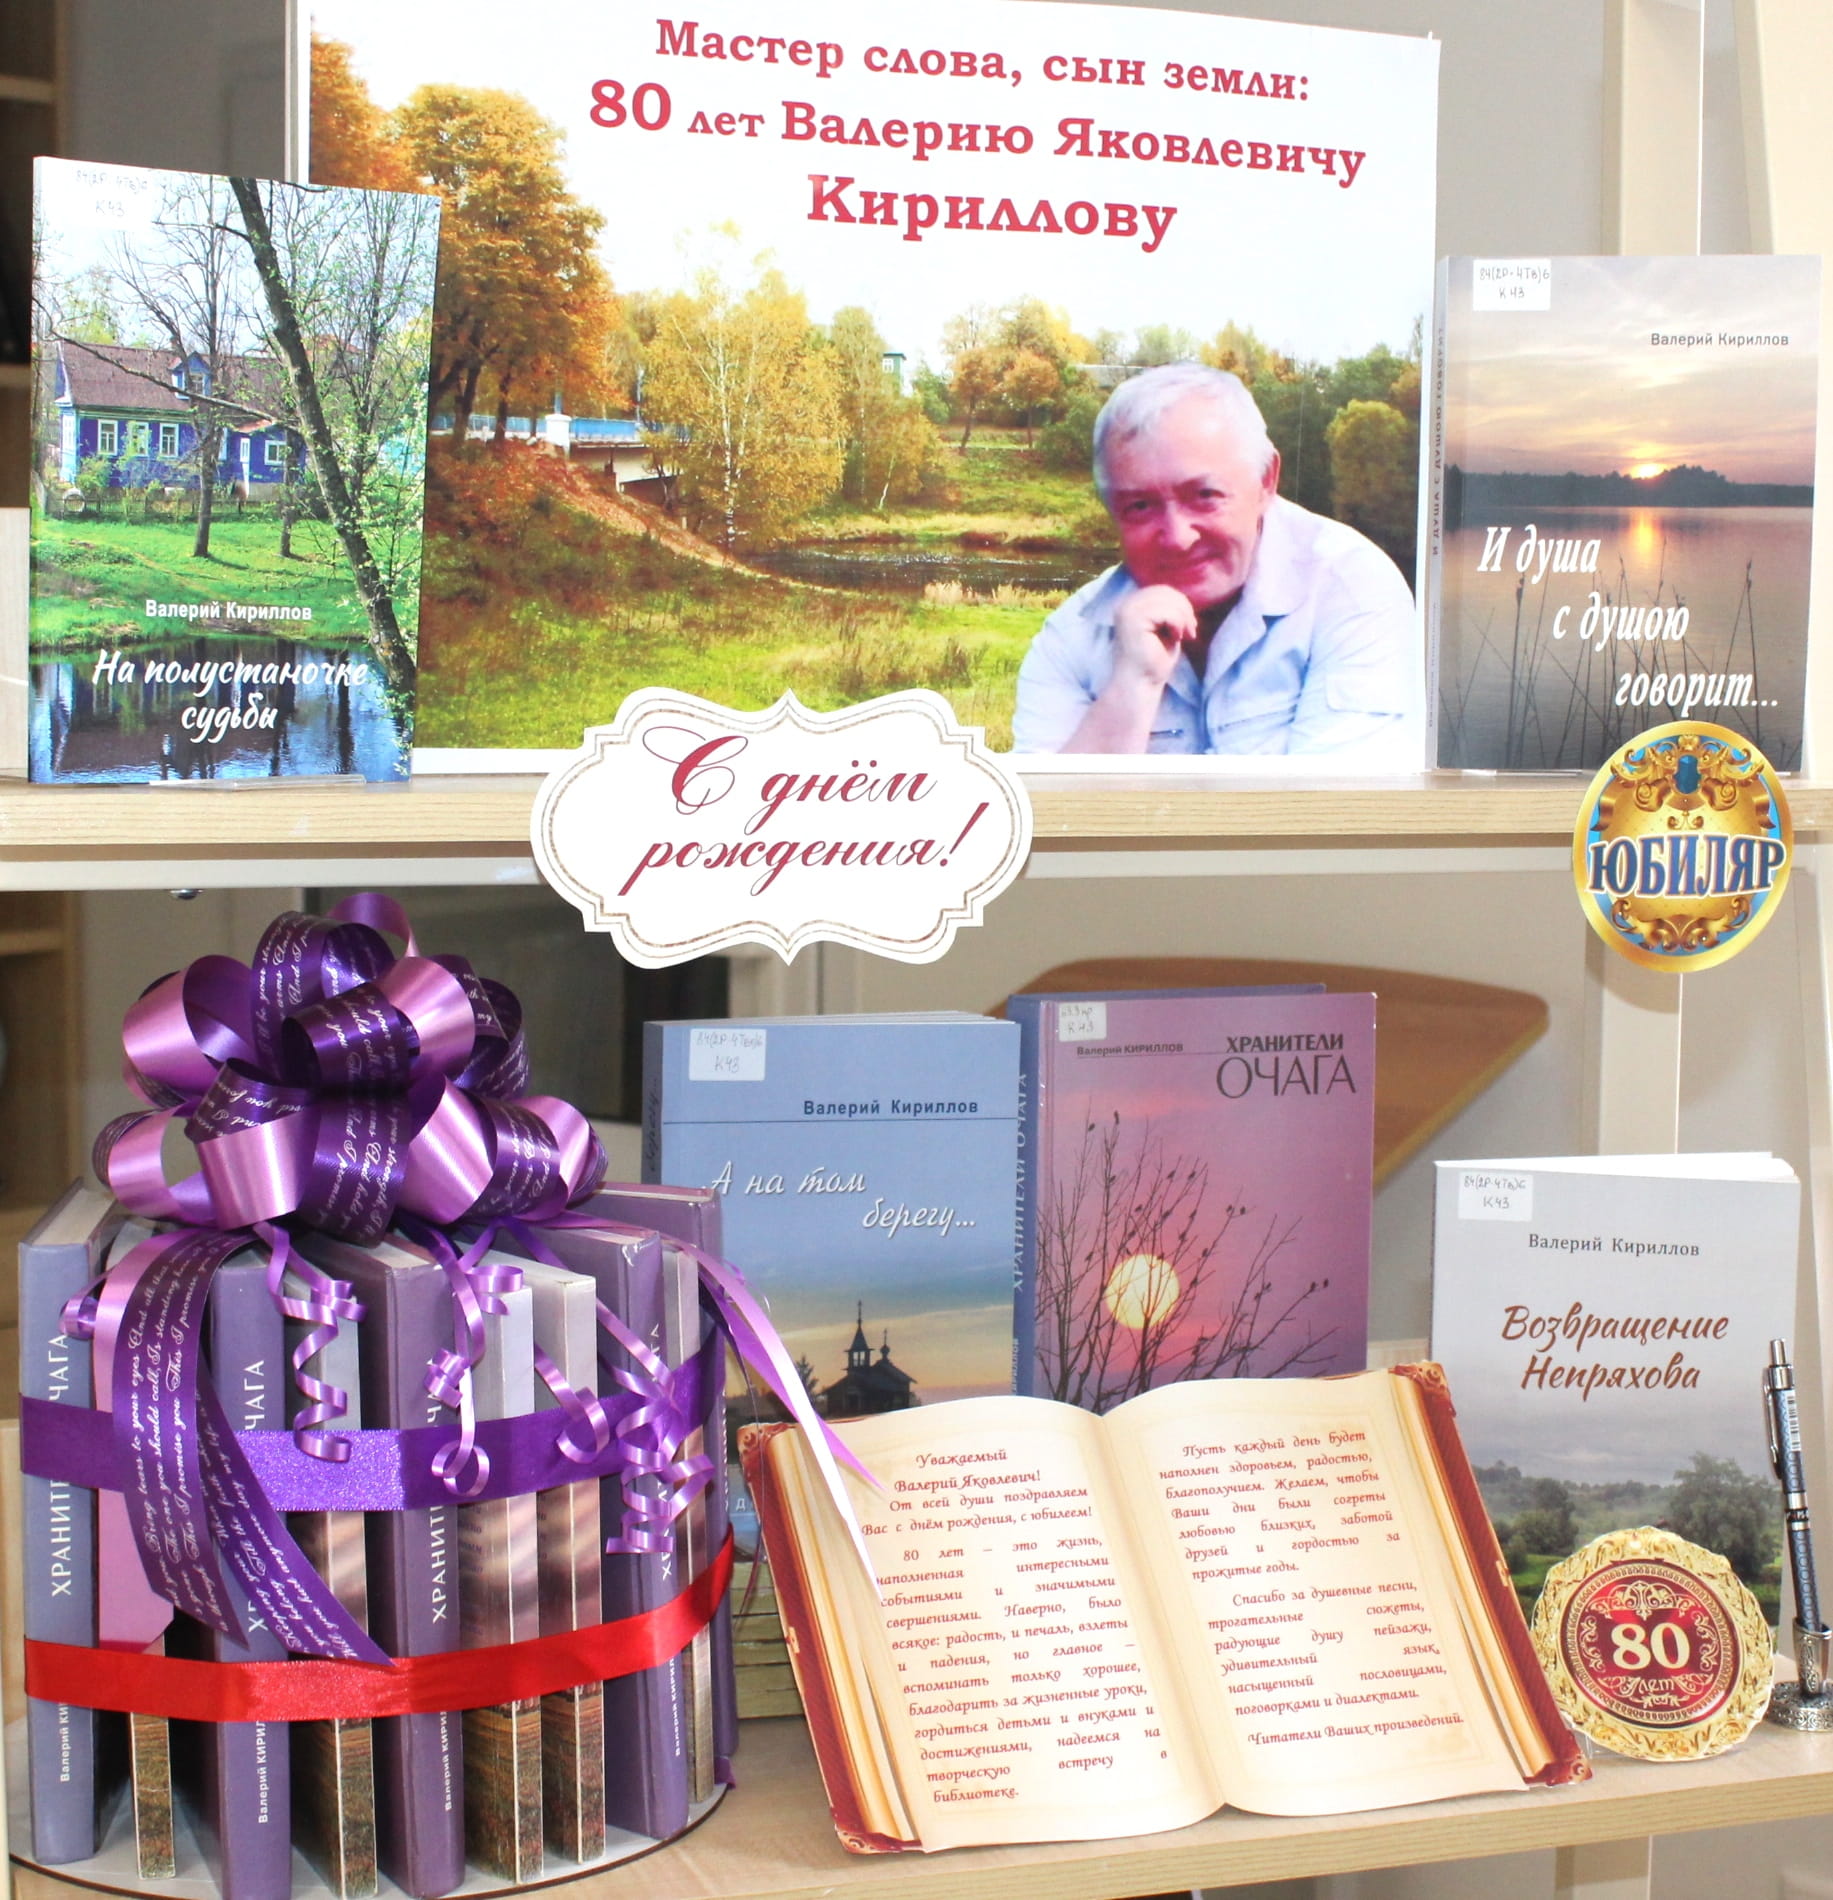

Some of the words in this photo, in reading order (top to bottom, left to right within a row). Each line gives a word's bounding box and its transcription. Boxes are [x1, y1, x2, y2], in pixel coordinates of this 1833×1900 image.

[654, 18, 844, 79] Мастер
[861, 43, 1023, 88] слова,
[1041, 53, 1147, 89] сын
[1163, 60, 1311, 102] земли:
[588, 78, 673, 133] 80
[687, 108, 765, 138] лет
[781, 100, 1034, 160] Валерию
[1053, 118, 1368, 188] Яковлевичу
[806, 173, 1178, 254] Кириллову
[1650, 332, 1713, 349] Валерий
[1718, 333, 1789, 349] Кириллов
[1477, 526, 1512, 573] И
[1515, 523, 1602, 585] душа
[145, 599, 221, 622] Валерий
[225, 601, 313, 623] Кириллов
[1552, 607, 1571, 640] с
[1579, 591, 1690, 652] душою
[92, 648, 135, 686] На
[143, 658, 368, 698] полустаночке
[1615, 671, 1779, 718] говорит...
[181, 691, 278, 744] судьбы
[642, 725, 749, 815] С
[743, 758, 938, 836] днём
[617, 801, 990, 897] рождения!
[1586, 832, 1787, 899] ЮБИЛЯР
[1076, 1046, 1122, 1057] Валерий
[1124, 1043, 1184, 1054] КИРИЛЛОВ
[1226, 1033, 1344, 1054] ХРАНИТЕЛИ
[1216, 1054, 1357, 1099] ОЧАГА
[803, 1099, 880, 1119] Валерий
[891, 1099, 979, 1118] Кириллов
[701, 1160, 734, 1195] А
[745, 1169, 785, 1195] на
[797, 1166, 866, 1195] том
[862, 1197, 977, 1239] берегу...
[1528, 1233, 1602, 1253] Валерий
[1611, 1238, 1701, 1257] Кириллов
[1500, 1301, 1730, 1353] Возвращение
[132, 1354, 144, 1387] eyes
[165, 1349, 182, 1392] This
[1520, 1351, 1701, 1402] Непряхова
[131, 1392, 144, 1432] your
[174, 1397, 186, 1429] you
[146, 1405, 162, 1458] should
[1183, 1445, 1226, 1459] Пусть
[1234, 1438, 1285, 1454] каждый
[1293, 1436, 1320, 1447] день
[1329, 1430, 1365, 1447] будет
[173, 1432, 192, 1498] promise
[916, 1449, 1007, 1468] Уважаемый
[1160, 1467, 1219, 1479] наполнен
[1230, 1461, 1296, 1475] здоровьем,
[1306, 1453, 1372, 1470] радостью,
[157, 1461, 171, 1493] you
[894, 1477, 958, 1494] Валерий
[957, 1470, 1040, 1488] Яковлевич!
[1166, 1483, 1264, 1499] благополучием.
[1275, 1478, 1328, 1491] Желаем,
[1336, 1469, 1379, 1484] чтобы
[890, 1501, 912, 1511] От
[923, 1497, 950, 1508] всей
[960, 1495, 994, 1509] души
[1004, 1489, 1088, 1503] поздравляем
[1171, 1508, 1210, 1519] Ваши
[1233, 1502, 1256, 1513] дни
[1278, 1497, 1311, 1509] были
[1334, 1493, 1386, 1507] согреты
[861, 1524, 887, 1536] Вас
[910, 1519, 944, 1531] днём
[947, 1514, 1016, 1532] рождения,
[1031, 1506, 1091, 1521] юбилеем!
[1179, 1525, 1235, 1539] любовью
[1261, 1520, 1315, 1531] близких,
[1341, 1511, 1393, 1524] заботой
[904, 1550, 919, 1561] 80
[939, 1549, 964, 1558] лет
[1013, 1542, 1037, 1551] это
[1057, 1537, 1102, 1549] жизнь,
[1186, 1546, 1228, 1562] друзей
[1292, 1537, 1359, 1552] гордостью
[1387, 1533, 1400, 1541] за
[1016, 1558, 1109, 1573] интересными
[1192, 1565, 1261, 1583] прожитые
[1266, 1560, 1299, 1572] годы.
[881, 1592, 963, 1607] событиями
[1036, 1578, 1115, 1592] значимыми
[1233, 1589, 1285, 1606] Спасибо
[1292, 1592, 1305, 1600] за
[1312, 1586, 1372, 1602] душевные
[1378, 1582, 1417, 1592] песни,
[887, 1612, 981, 1630] свершениями.
[1004, 1604, 1065, 1617] Наверно,
[1089, 1596, 1121, 1608] было
[1208, 1613, 1303, 1632] трогательные
[1367, 1603, 1424, 1615] сюжеты,
[892, 1637, 939, 1650] всякое:
[946, 1631, 1005, 1648] радость,
[1024, 1625, 1073, 1636] печаль,
[1079, 1620, 1128, 1631] взлеты
[1214, 1637, 1280, 1655] радующие
[1312, 1630, 1343, 1645] душу
[1374, 1624, 1431, 1635] пейзажи,
[1610, 1622, 1690, 1671] 80
[930, 1654, 990, 1668] падения,
[1014, 1651, 1029, 1660] но
[1053, 1644, 1102, 1656] главное
[1221, 1653, 1317, 1676] удивительный
[1403, 1644, 1440, 1655] язык,
[903, 1678, 989, 1694] вспоминать
[1011, 1671, 1061, 1683] только
[1083, 1663, 1140, 1678] хорошее,
[1228, 1675, 1314, 1693] насыщенный
[1360, 1666, 1447, 1680] пословицами,
[1637, 1677, 1675, 1694] лет
[909, 1700, 998, 1716] благодарить
[1004, 1697, 1018, 1706] за
[1022, 1689, 1099, 1706] жизненные
[1104, 1685, 1147, 1700] уроки,
[1235, 1698, 1320, 1715] поговорками
[1336, 1690, 1419, 1705] диалектами.
[915, 1723, 988, 1741] гордиться
[998, 1717, 1051, 1730] детьми
[1078, 1708, 1136, 1724] внуками
[1248, 1731, 1322, 1745] Читатели
[1324, 1725, 1374, 1737] Ваших
[1374, 1713, 1464, 1735] произведений.
[60, 1727, 71, 1782] Валерий
[921, 1742, 1032, 1760] достижениями,
[1057, 1732, 1120, 1746] надеемся
[1144, 1728, 1160, 1737] на
[442, 1754, 452, 1812] Валерий
[926, 1767, 1010, 1783] творческую
[1059, 1756, 1113, 1771] встречу
[257, 1767, 269, 1823] Валерий
[934, 1788, 1018, 1802] библиотеке.
